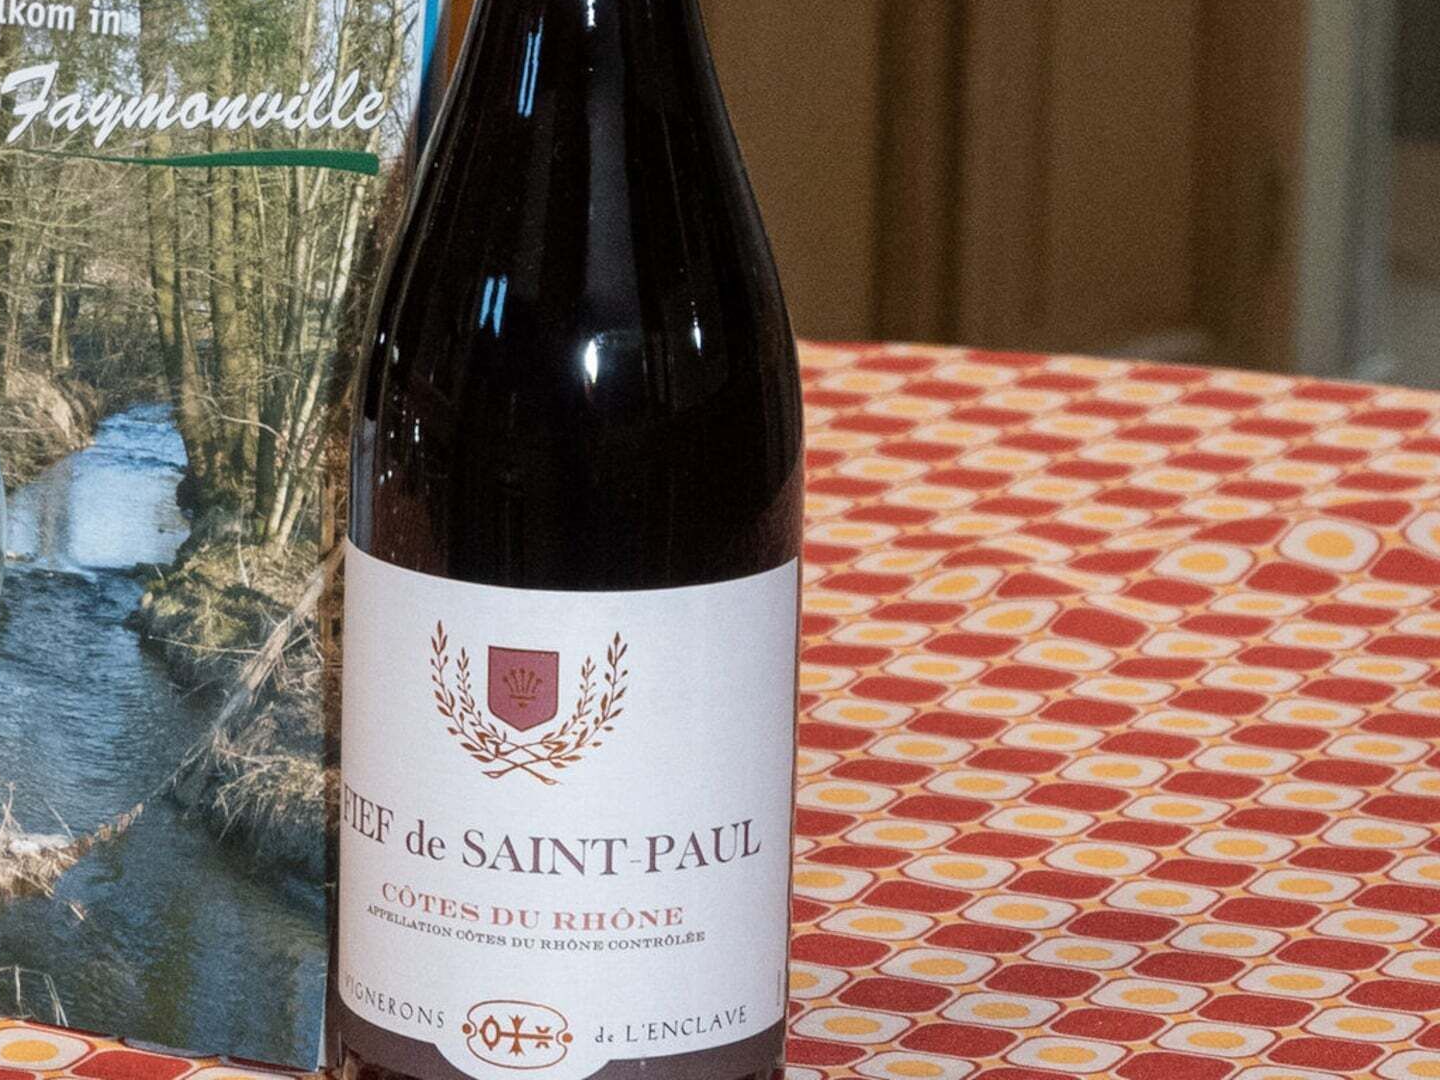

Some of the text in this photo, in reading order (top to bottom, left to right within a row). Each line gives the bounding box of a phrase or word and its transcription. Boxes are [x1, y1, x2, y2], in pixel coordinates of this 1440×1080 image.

[90, 3, 122, 36] in
[0, 60, 388, 148] Faymonville
[343, 782, 762, 877] FIEF de SAINT-PAUL
[367, 903, 453, 939] APPELLATION
[455, 928, 508, 947] CÔTES
[511, 937, 536, 951] DU
[540, 938, 604, 952] RHÔNE
[382, 881, 685, 932] CÔTES DU RHÔNE
[594, 1026, 615, 1044] de
[625, 1004, 748, 1043] L'ENCLAVE
